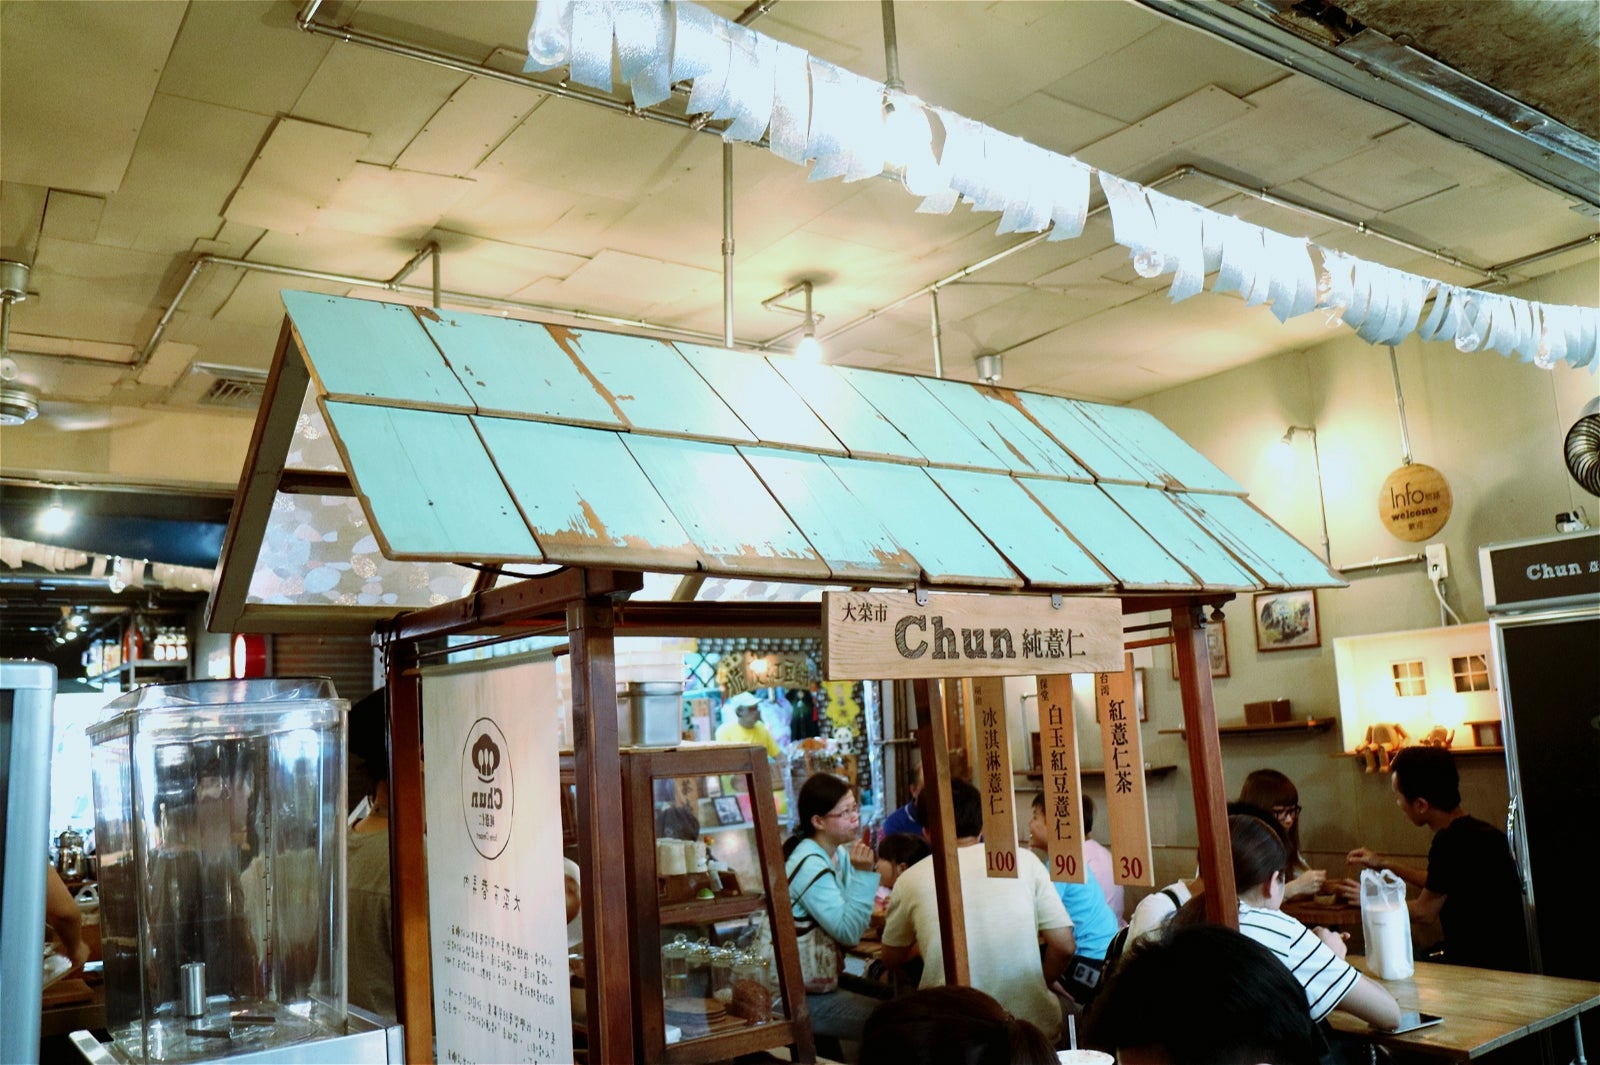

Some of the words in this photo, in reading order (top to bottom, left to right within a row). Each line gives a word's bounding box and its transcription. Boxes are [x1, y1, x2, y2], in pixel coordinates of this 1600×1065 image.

[1390, 482, 1425, 509] Info
[1391, 506, 1438, 522] welcome
[1526, 562, 1583, 581] Chun
[841, 602, 888, 623] 大菜市
[894, 614, 1017, 660] Chun
[1022, 627, 1087, 659] 純薏仁
[1108, 699, 1133, 795] 紅薏仁茶
[981, 706, 1005, 816] 冰淇淋薏仁
[1048, 704, 1072, 841] 白玉紅豆薏仁
[986, 850, 1016, 873] 100
[1055, 854, 1077, 877] 90
[1120, 857, 1143, 880] 30
